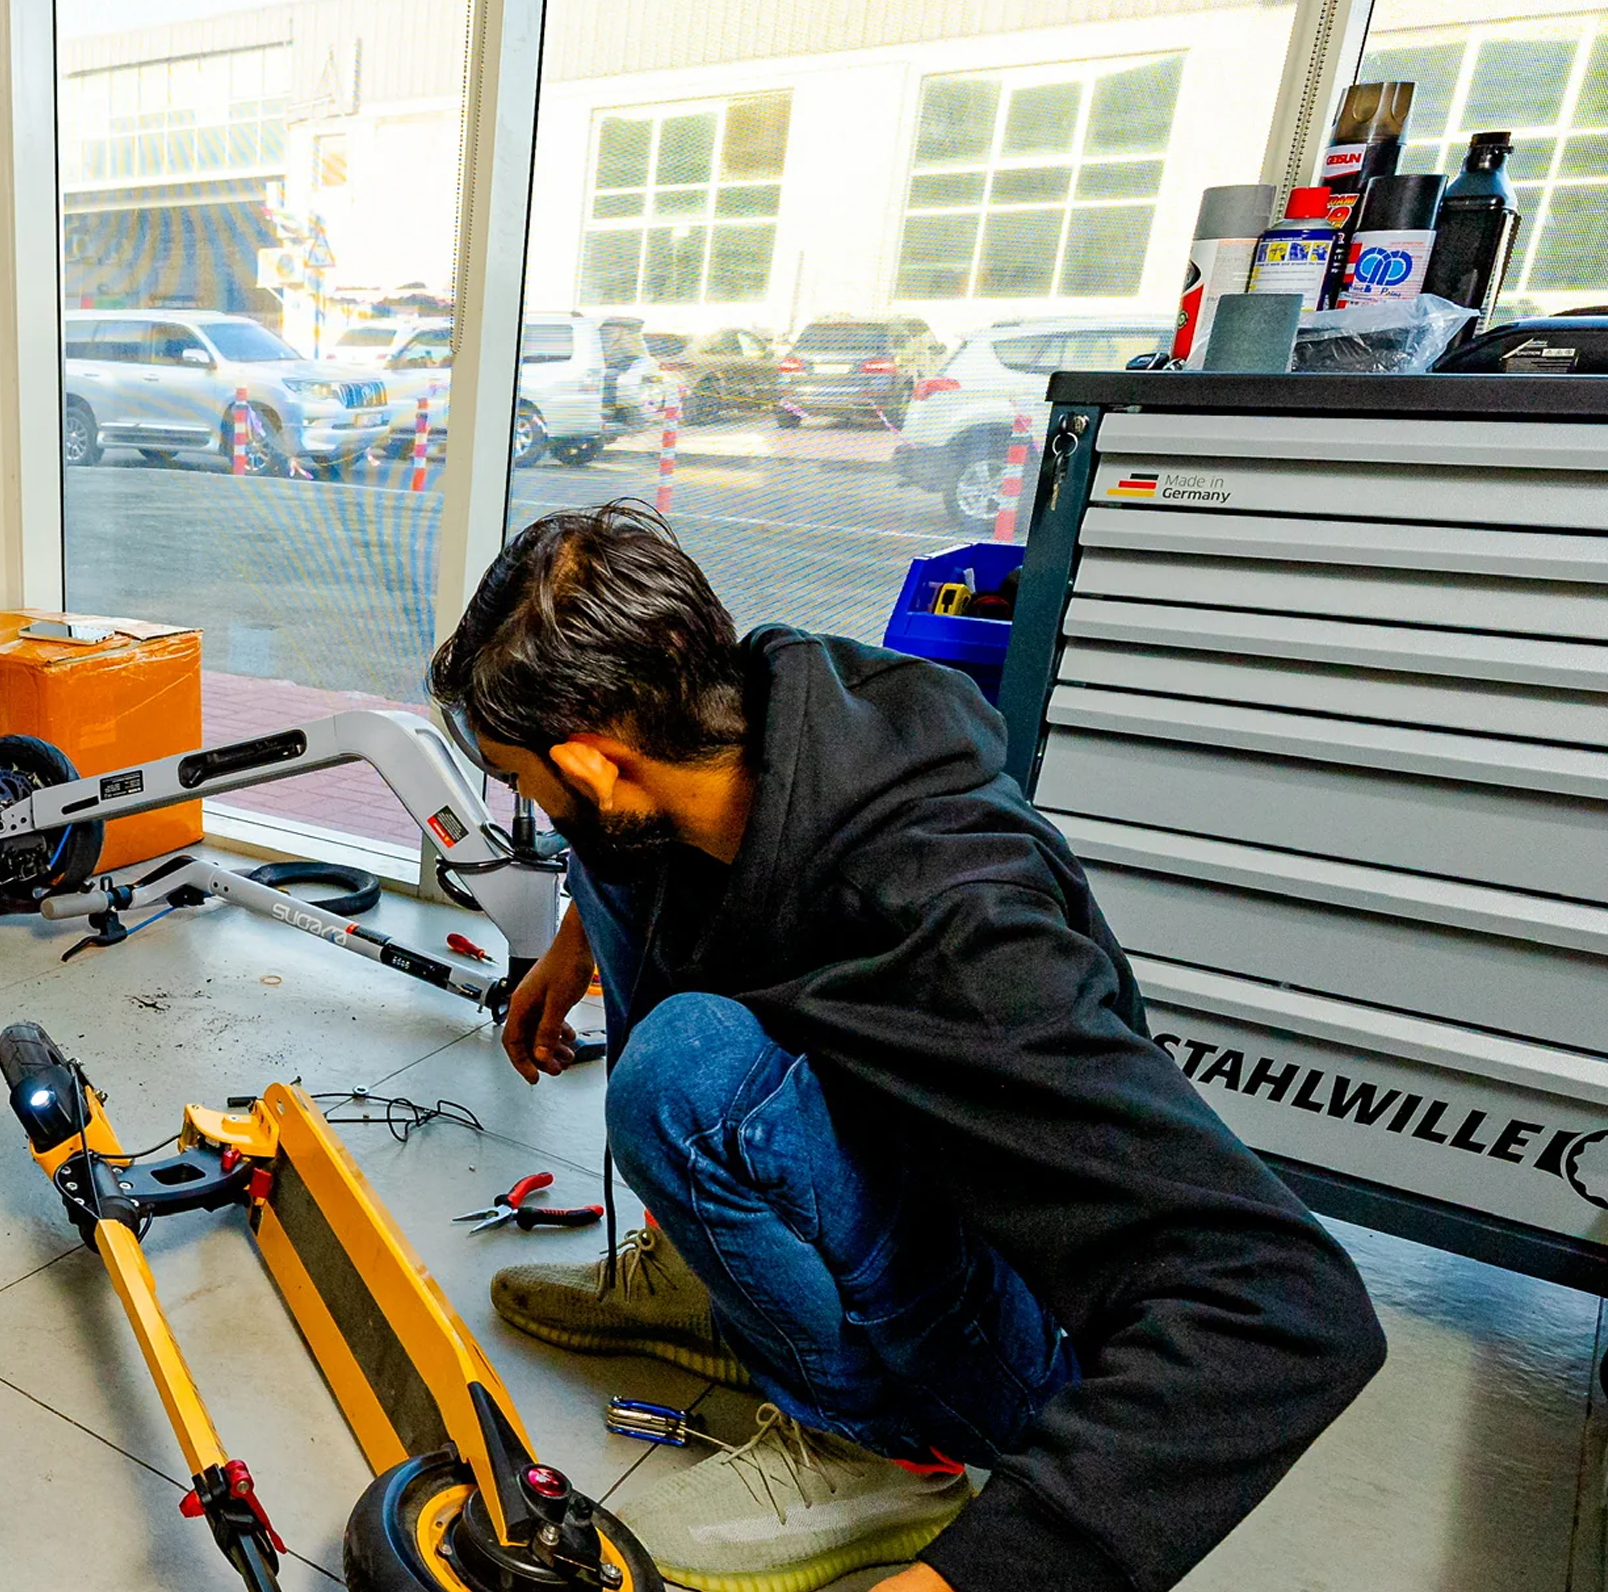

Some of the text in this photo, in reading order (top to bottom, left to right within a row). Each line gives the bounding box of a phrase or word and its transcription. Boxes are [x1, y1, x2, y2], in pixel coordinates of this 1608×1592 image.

[1165, 474, 1224, 488] Made in
[1162, 487, 1231, 503] Germany
